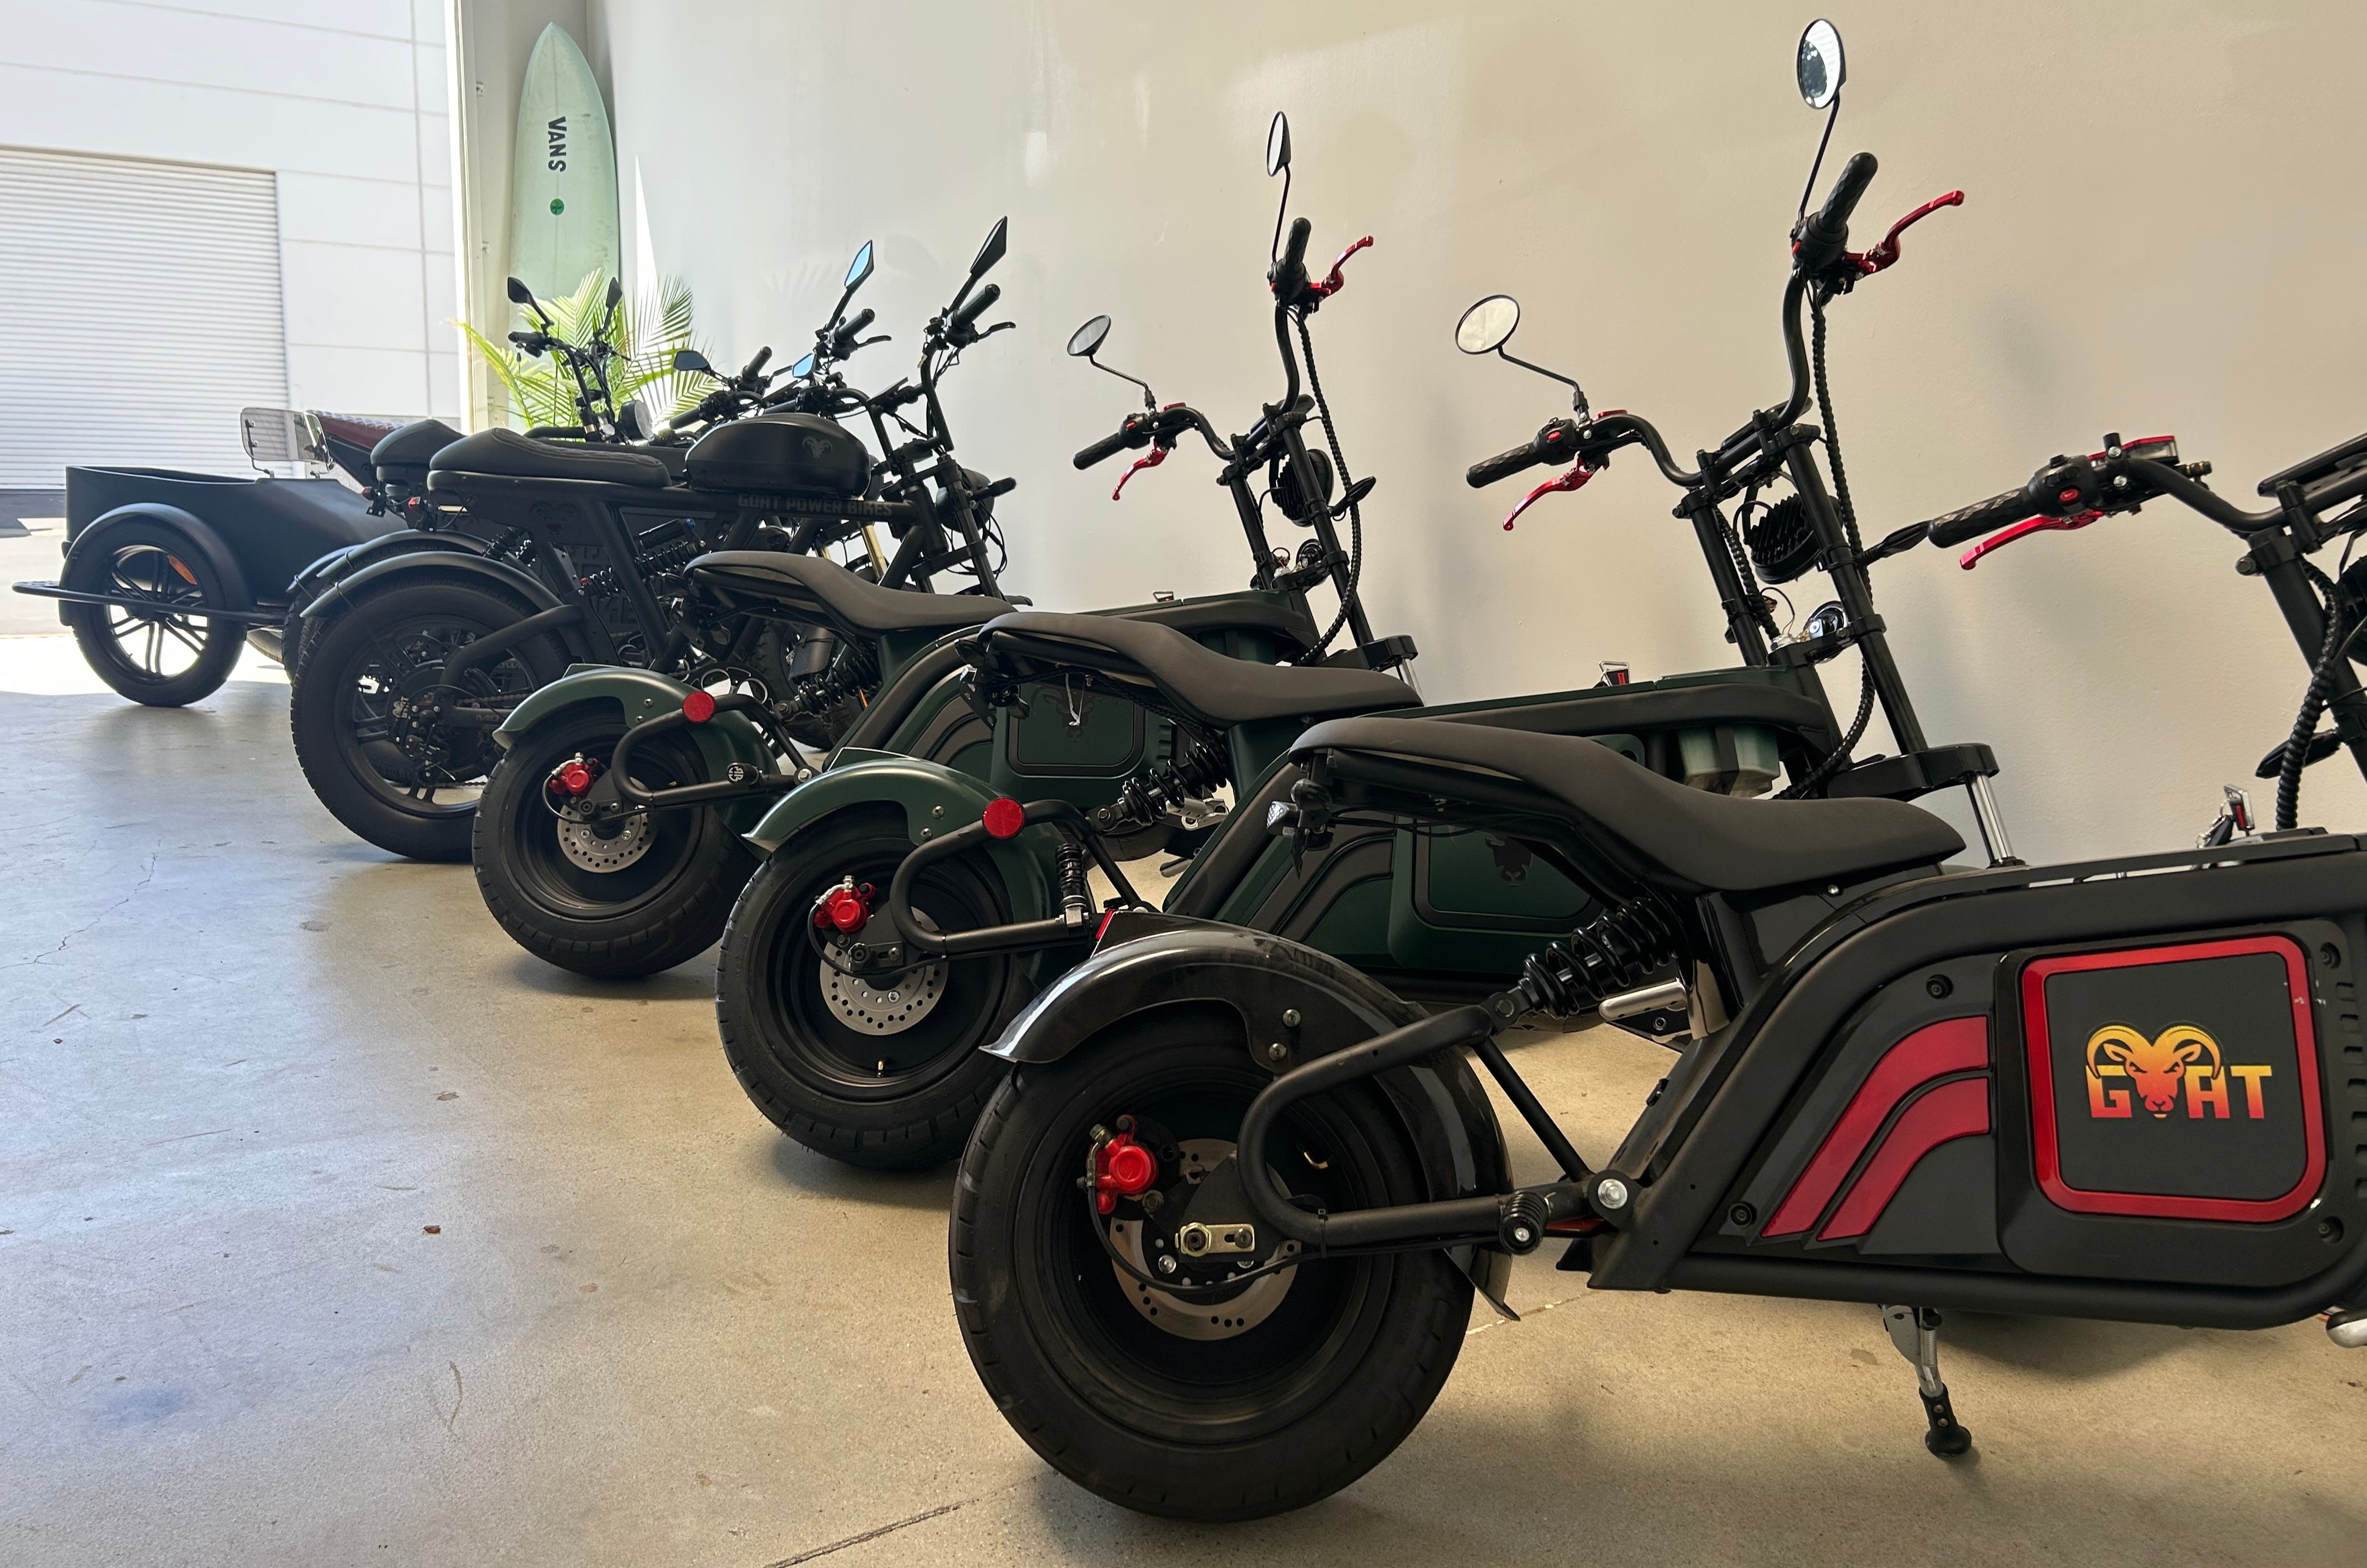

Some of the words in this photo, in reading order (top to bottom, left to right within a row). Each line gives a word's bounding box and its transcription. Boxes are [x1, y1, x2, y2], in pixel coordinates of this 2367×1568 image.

[548, 116, 567, 172] VANS
[785, 497, 842, 514] POWER
[847, 501, 893, 517] BIKES
